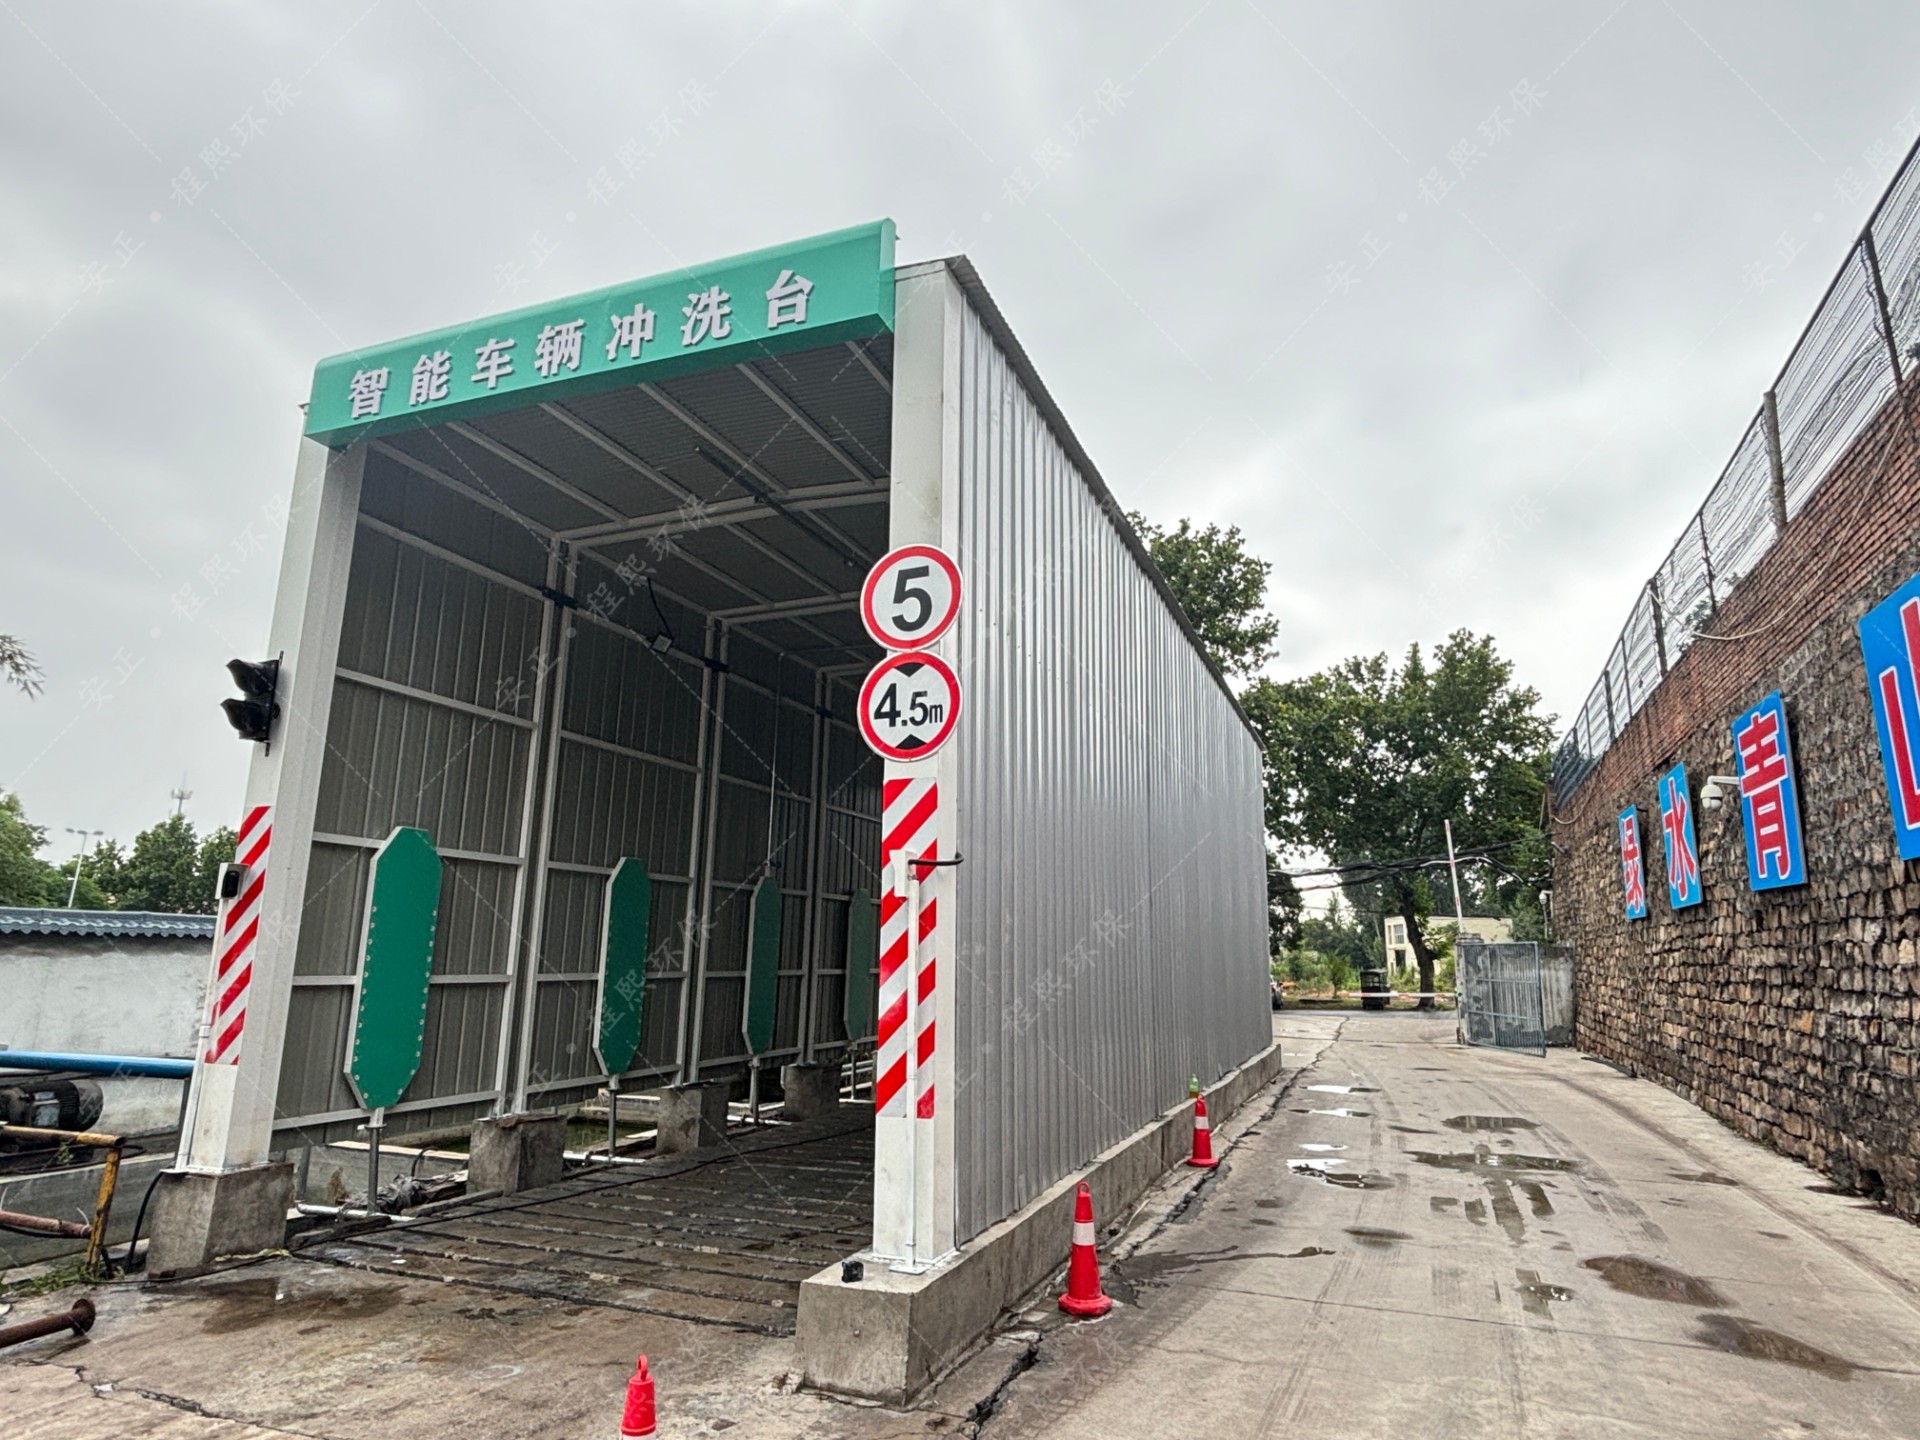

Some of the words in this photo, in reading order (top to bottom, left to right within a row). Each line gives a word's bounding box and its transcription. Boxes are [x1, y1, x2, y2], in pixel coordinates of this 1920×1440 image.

[348, 269, 816, 419] 智能车辆冲洗台
[891, 565, 933, 632] 5
[873, 682, 943, 727] 4.5m
